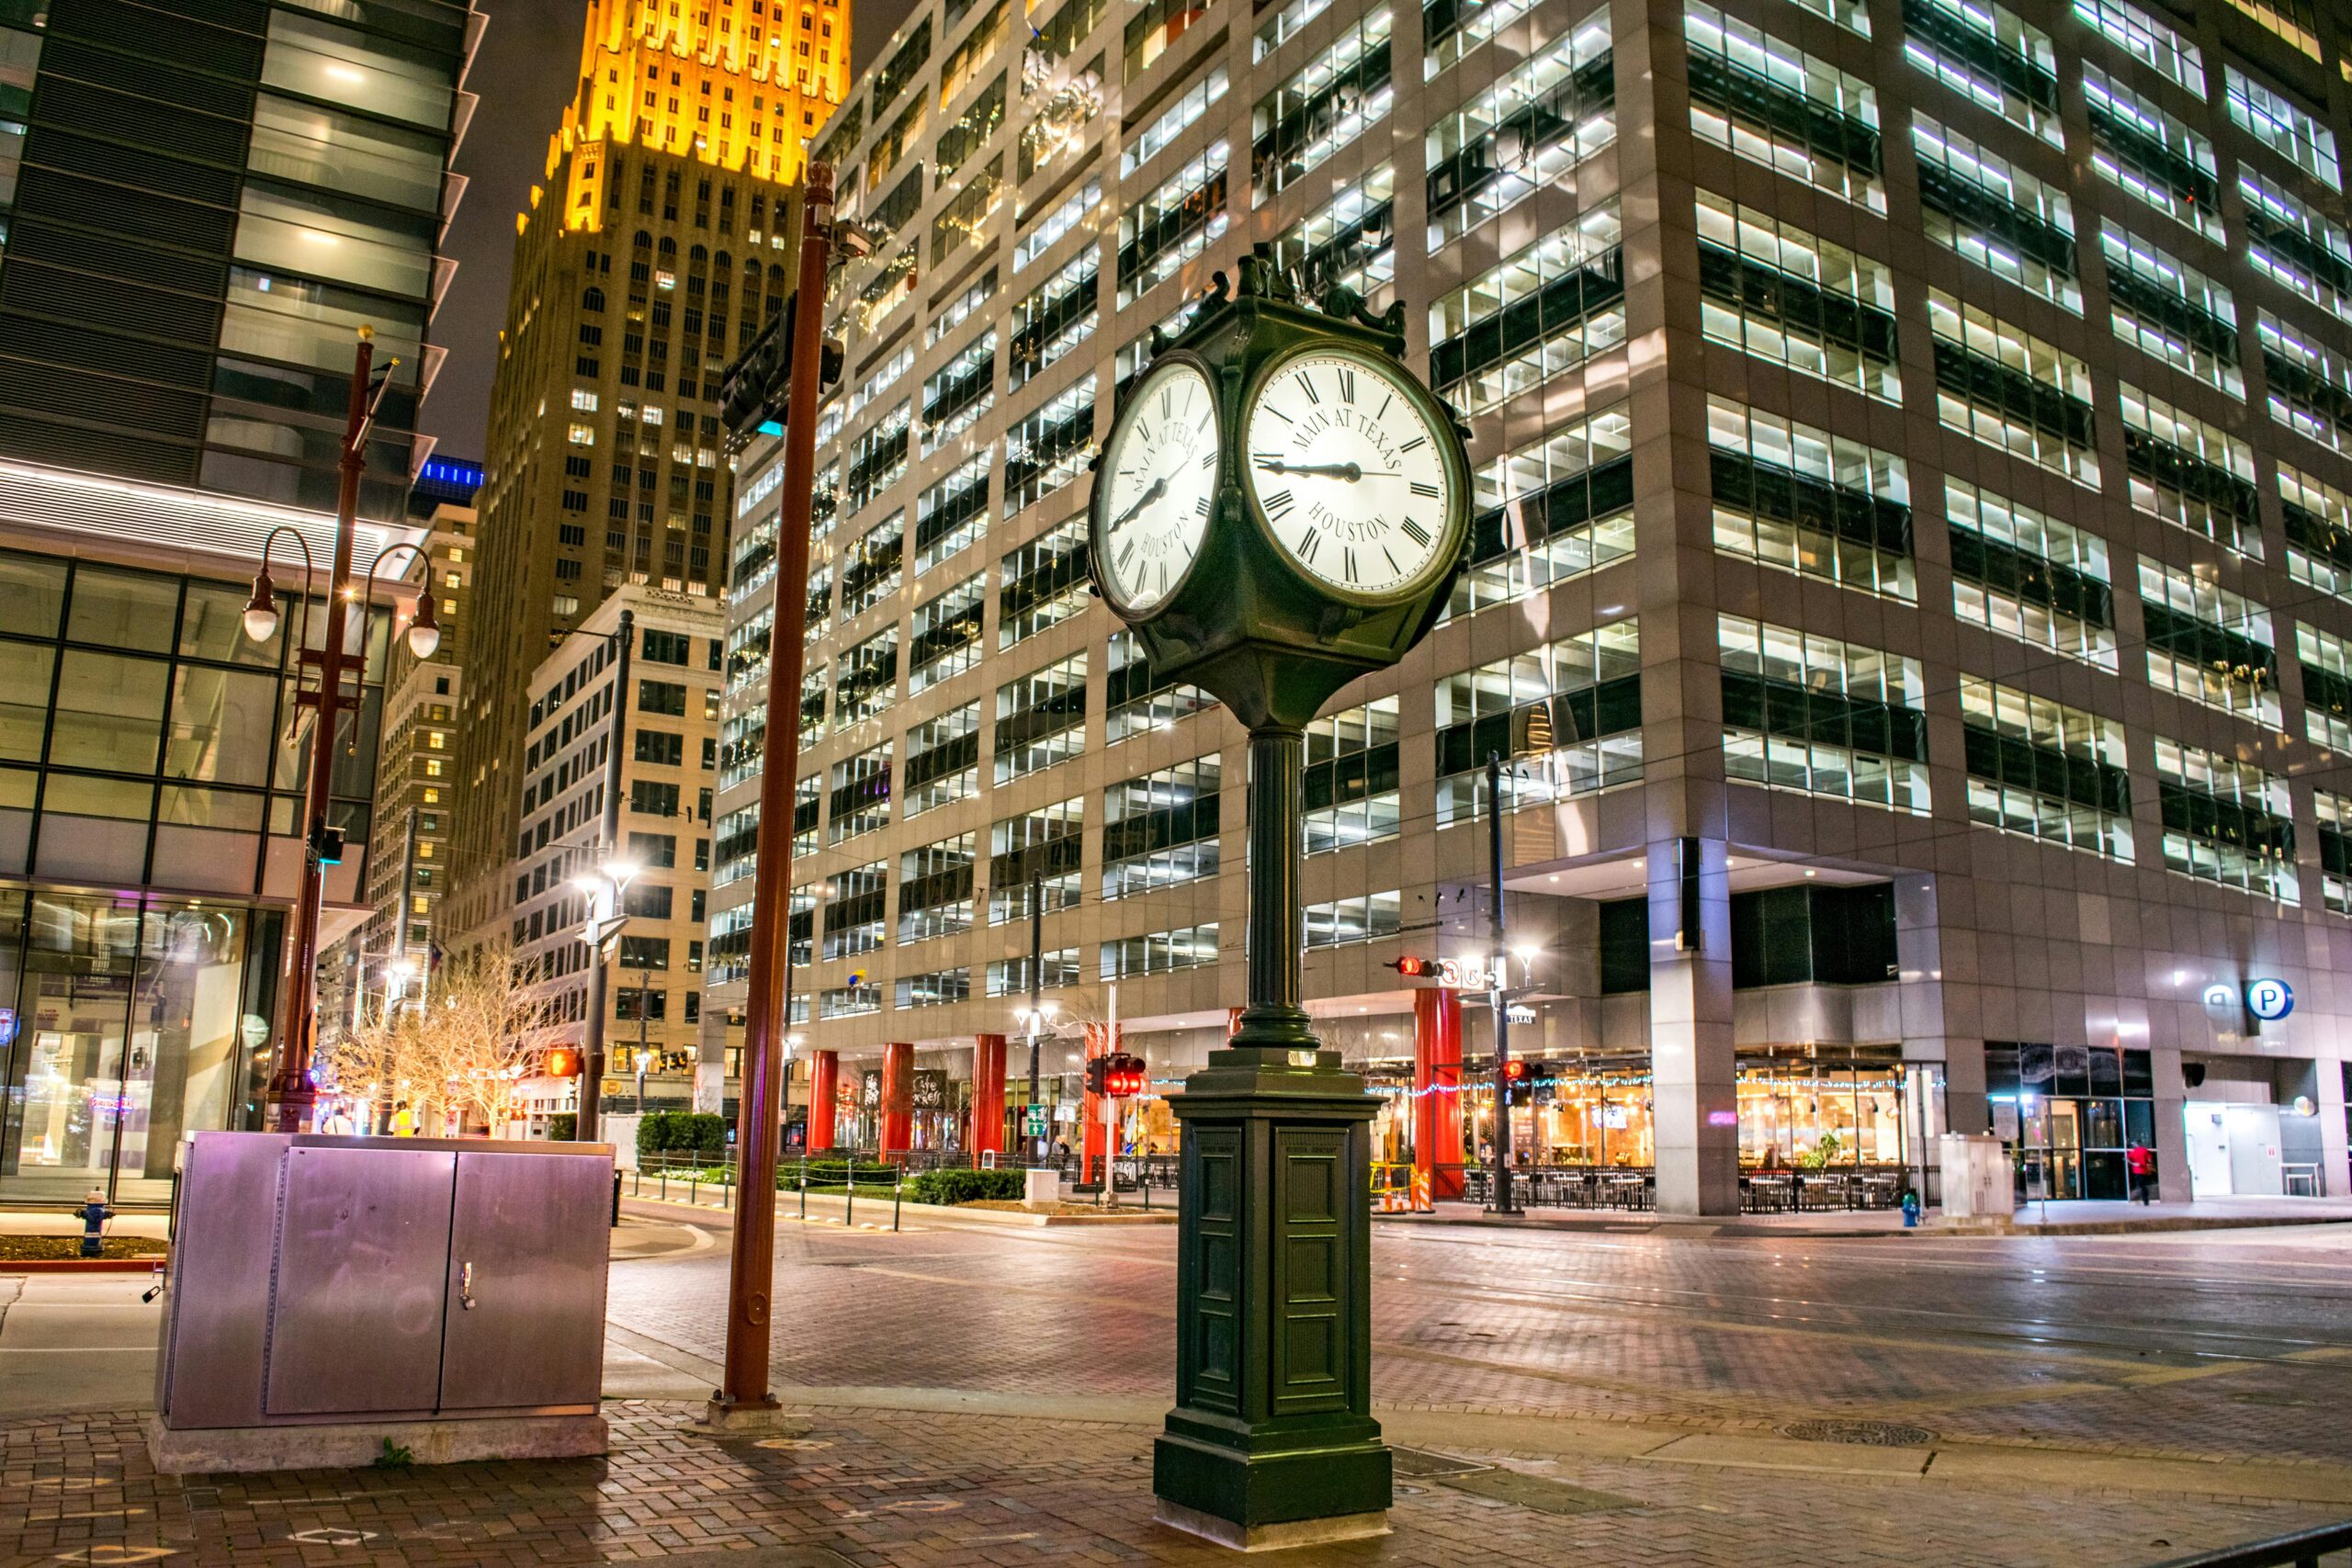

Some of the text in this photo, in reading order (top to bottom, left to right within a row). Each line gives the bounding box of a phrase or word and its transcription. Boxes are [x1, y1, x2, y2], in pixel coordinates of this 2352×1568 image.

[1337, 368, 1354, 404] XII
[1134, 422, 1198, 493] MAIN AT TEXAS
[1292, 408, 1402, 470] MAIN AT TEXAS
[1141, 510, 1189, 558] HOUSTON
[1307, 501, 1392, 543] HOUSTON
[1510, 1015, 1532, 1023] TEXAS
[2261, 989, 2277, 1010] P
